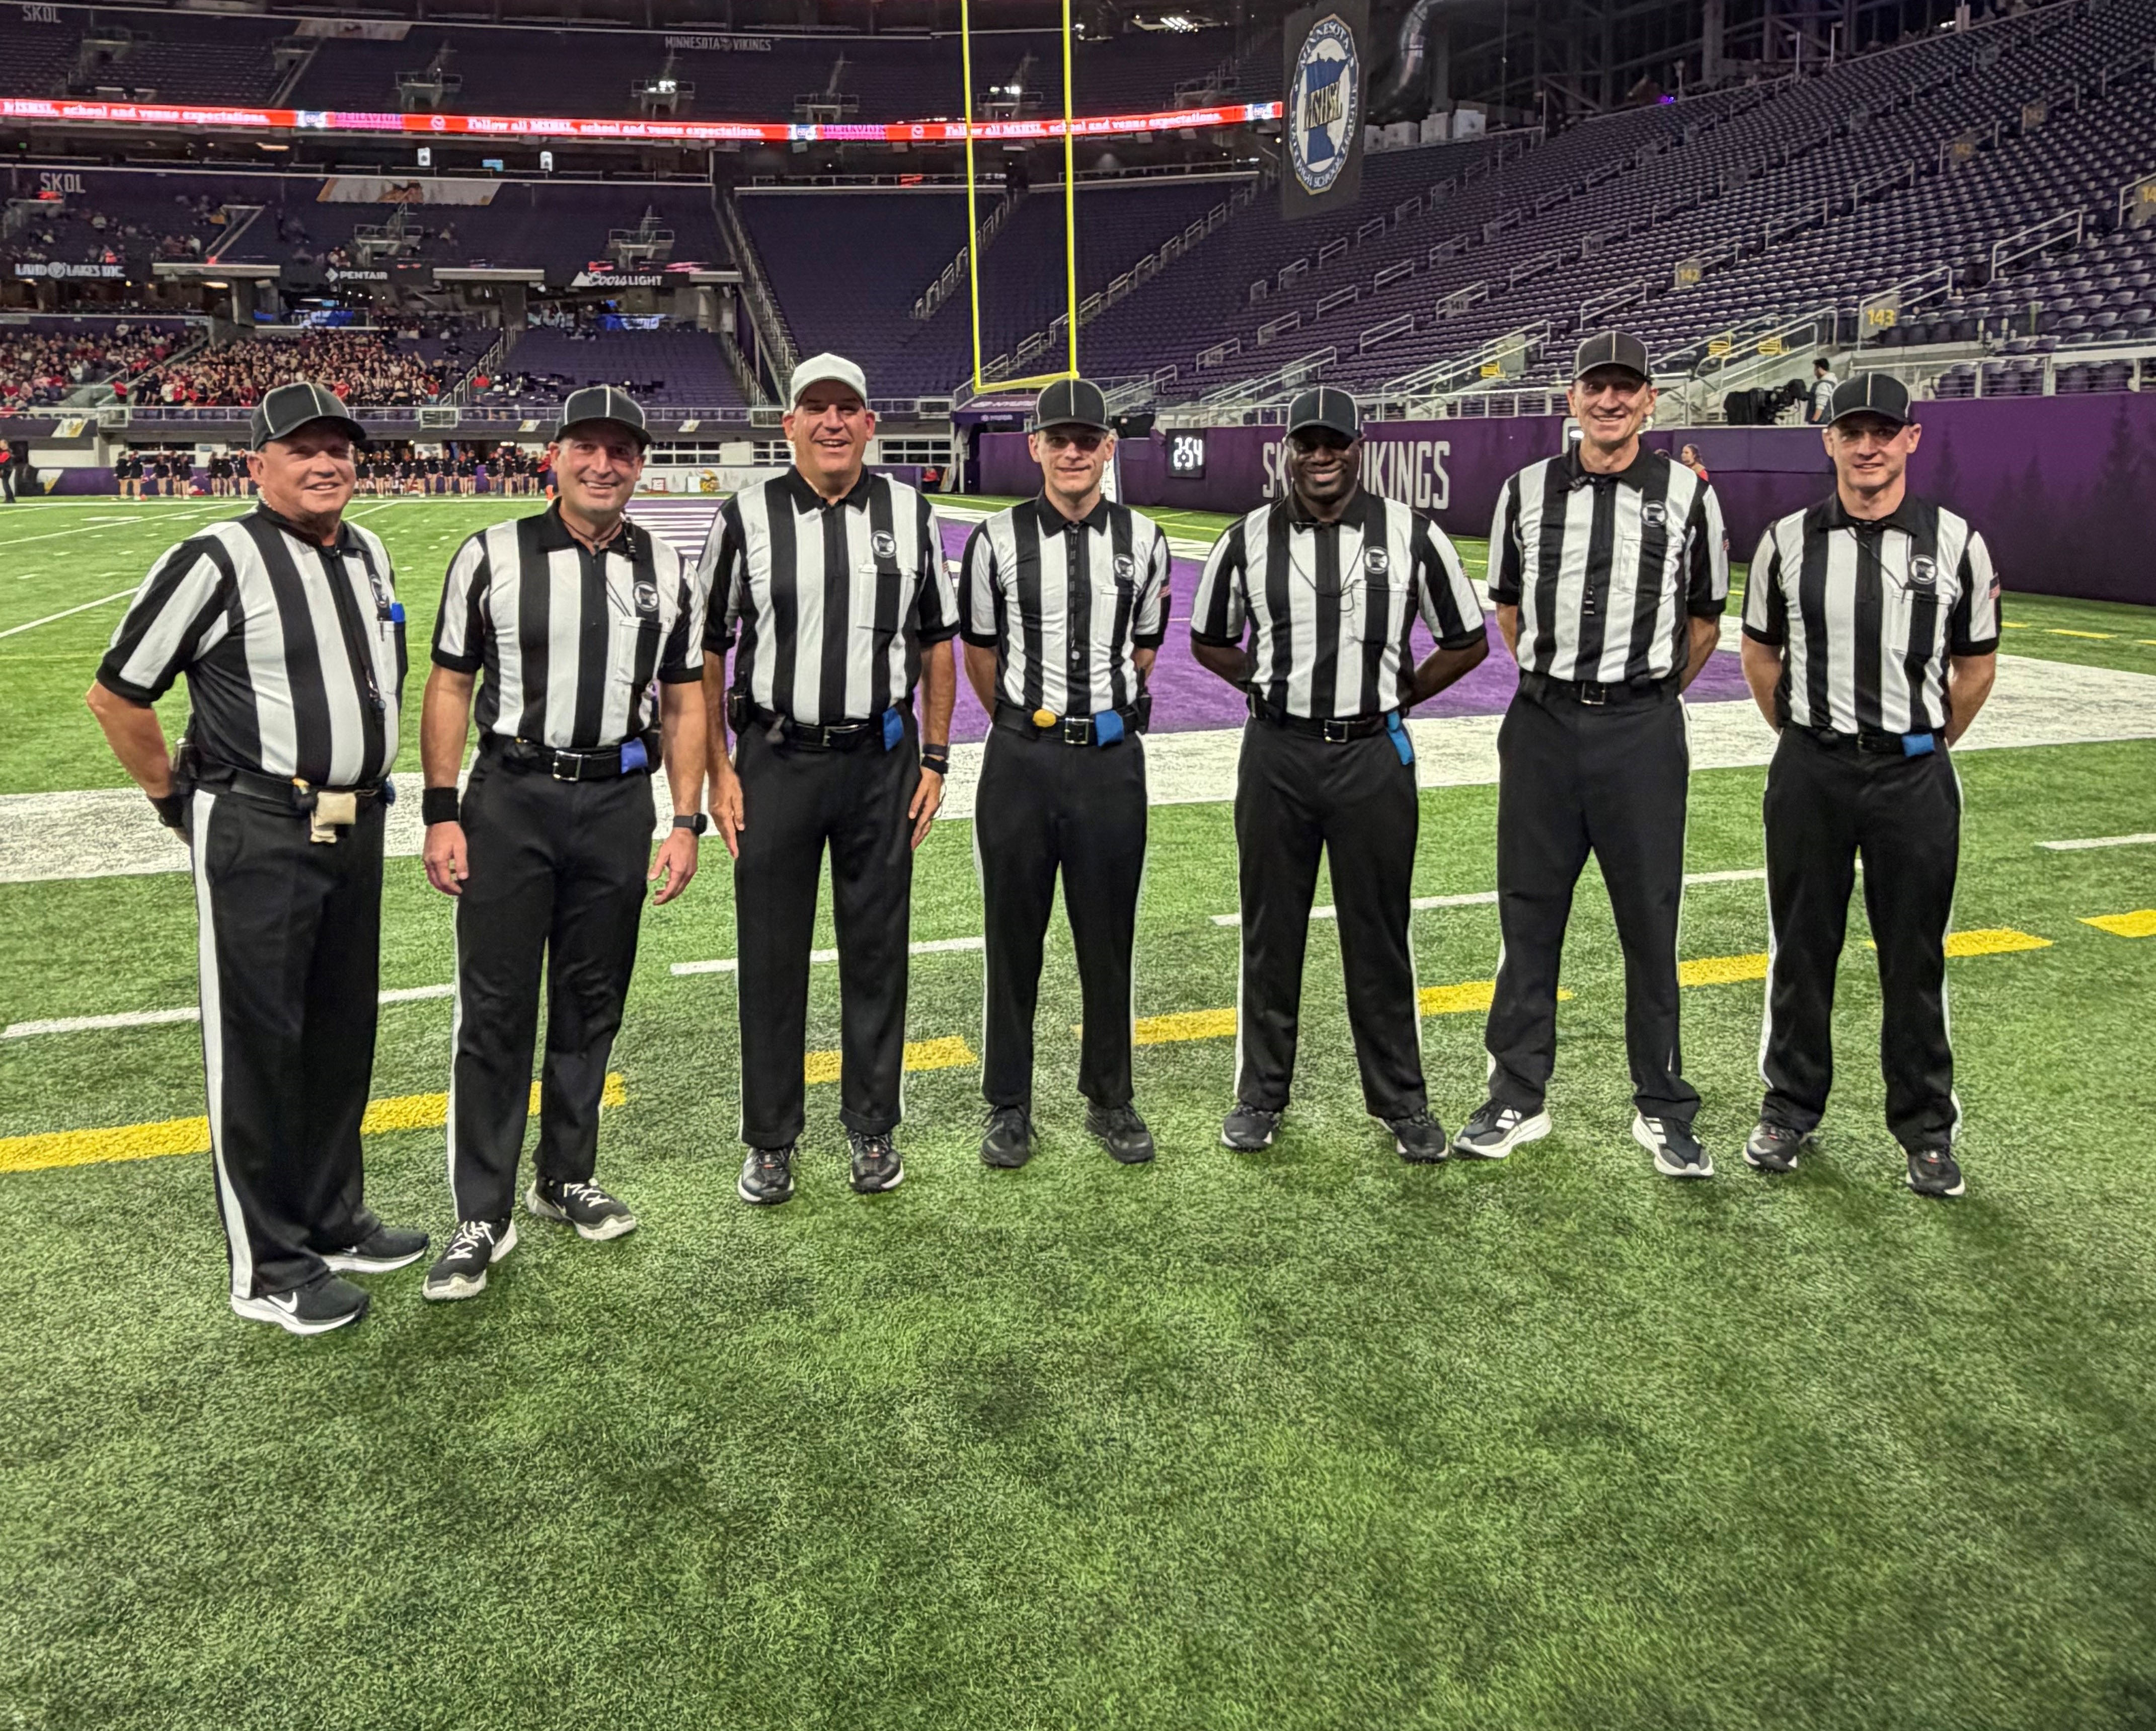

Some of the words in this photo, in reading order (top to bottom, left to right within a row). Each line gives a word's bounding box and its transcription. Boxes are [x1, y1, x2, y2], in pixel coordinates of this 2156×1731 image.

[23, 5, 62, 23] SKOL
[665, 36, 720, 49] MINNESOTA
[733, 38, 772, 51] VIKINGS
[40, 172, 86, 193] SKOL
[340, 271, 388, 280] PENTAIR
[629, 275, 662, 286] LIGHT
[1679, 268, 1700, 282] 142
[1867, 309, 1895, 327] 143
